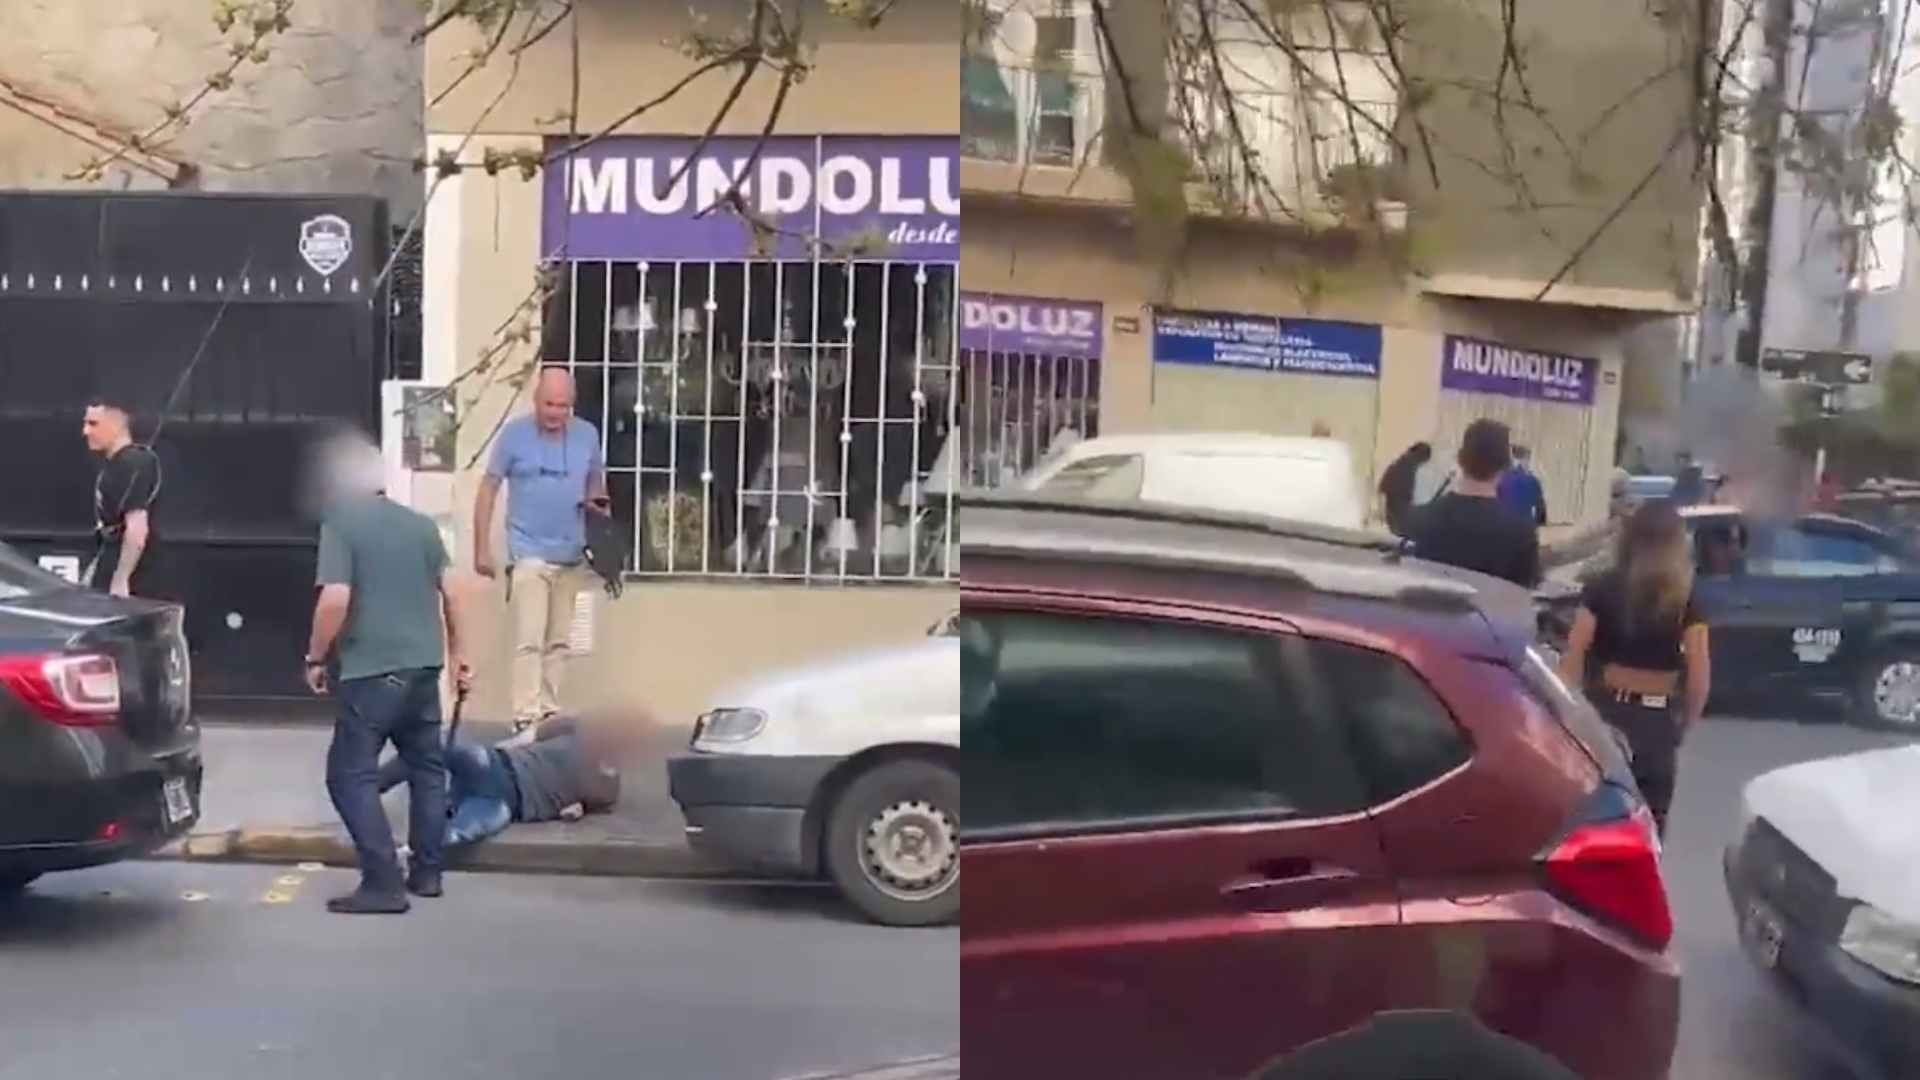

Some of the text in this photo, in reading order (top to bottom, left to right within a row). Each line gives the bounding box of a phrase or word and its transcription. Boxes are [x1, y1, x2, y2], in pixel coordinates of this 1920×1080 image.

[565, 155, 960, 215] MUNDOLU
[888, 221, 959, 244] desde
[1453, 340, 1584, 387] MUNDOLUZ
